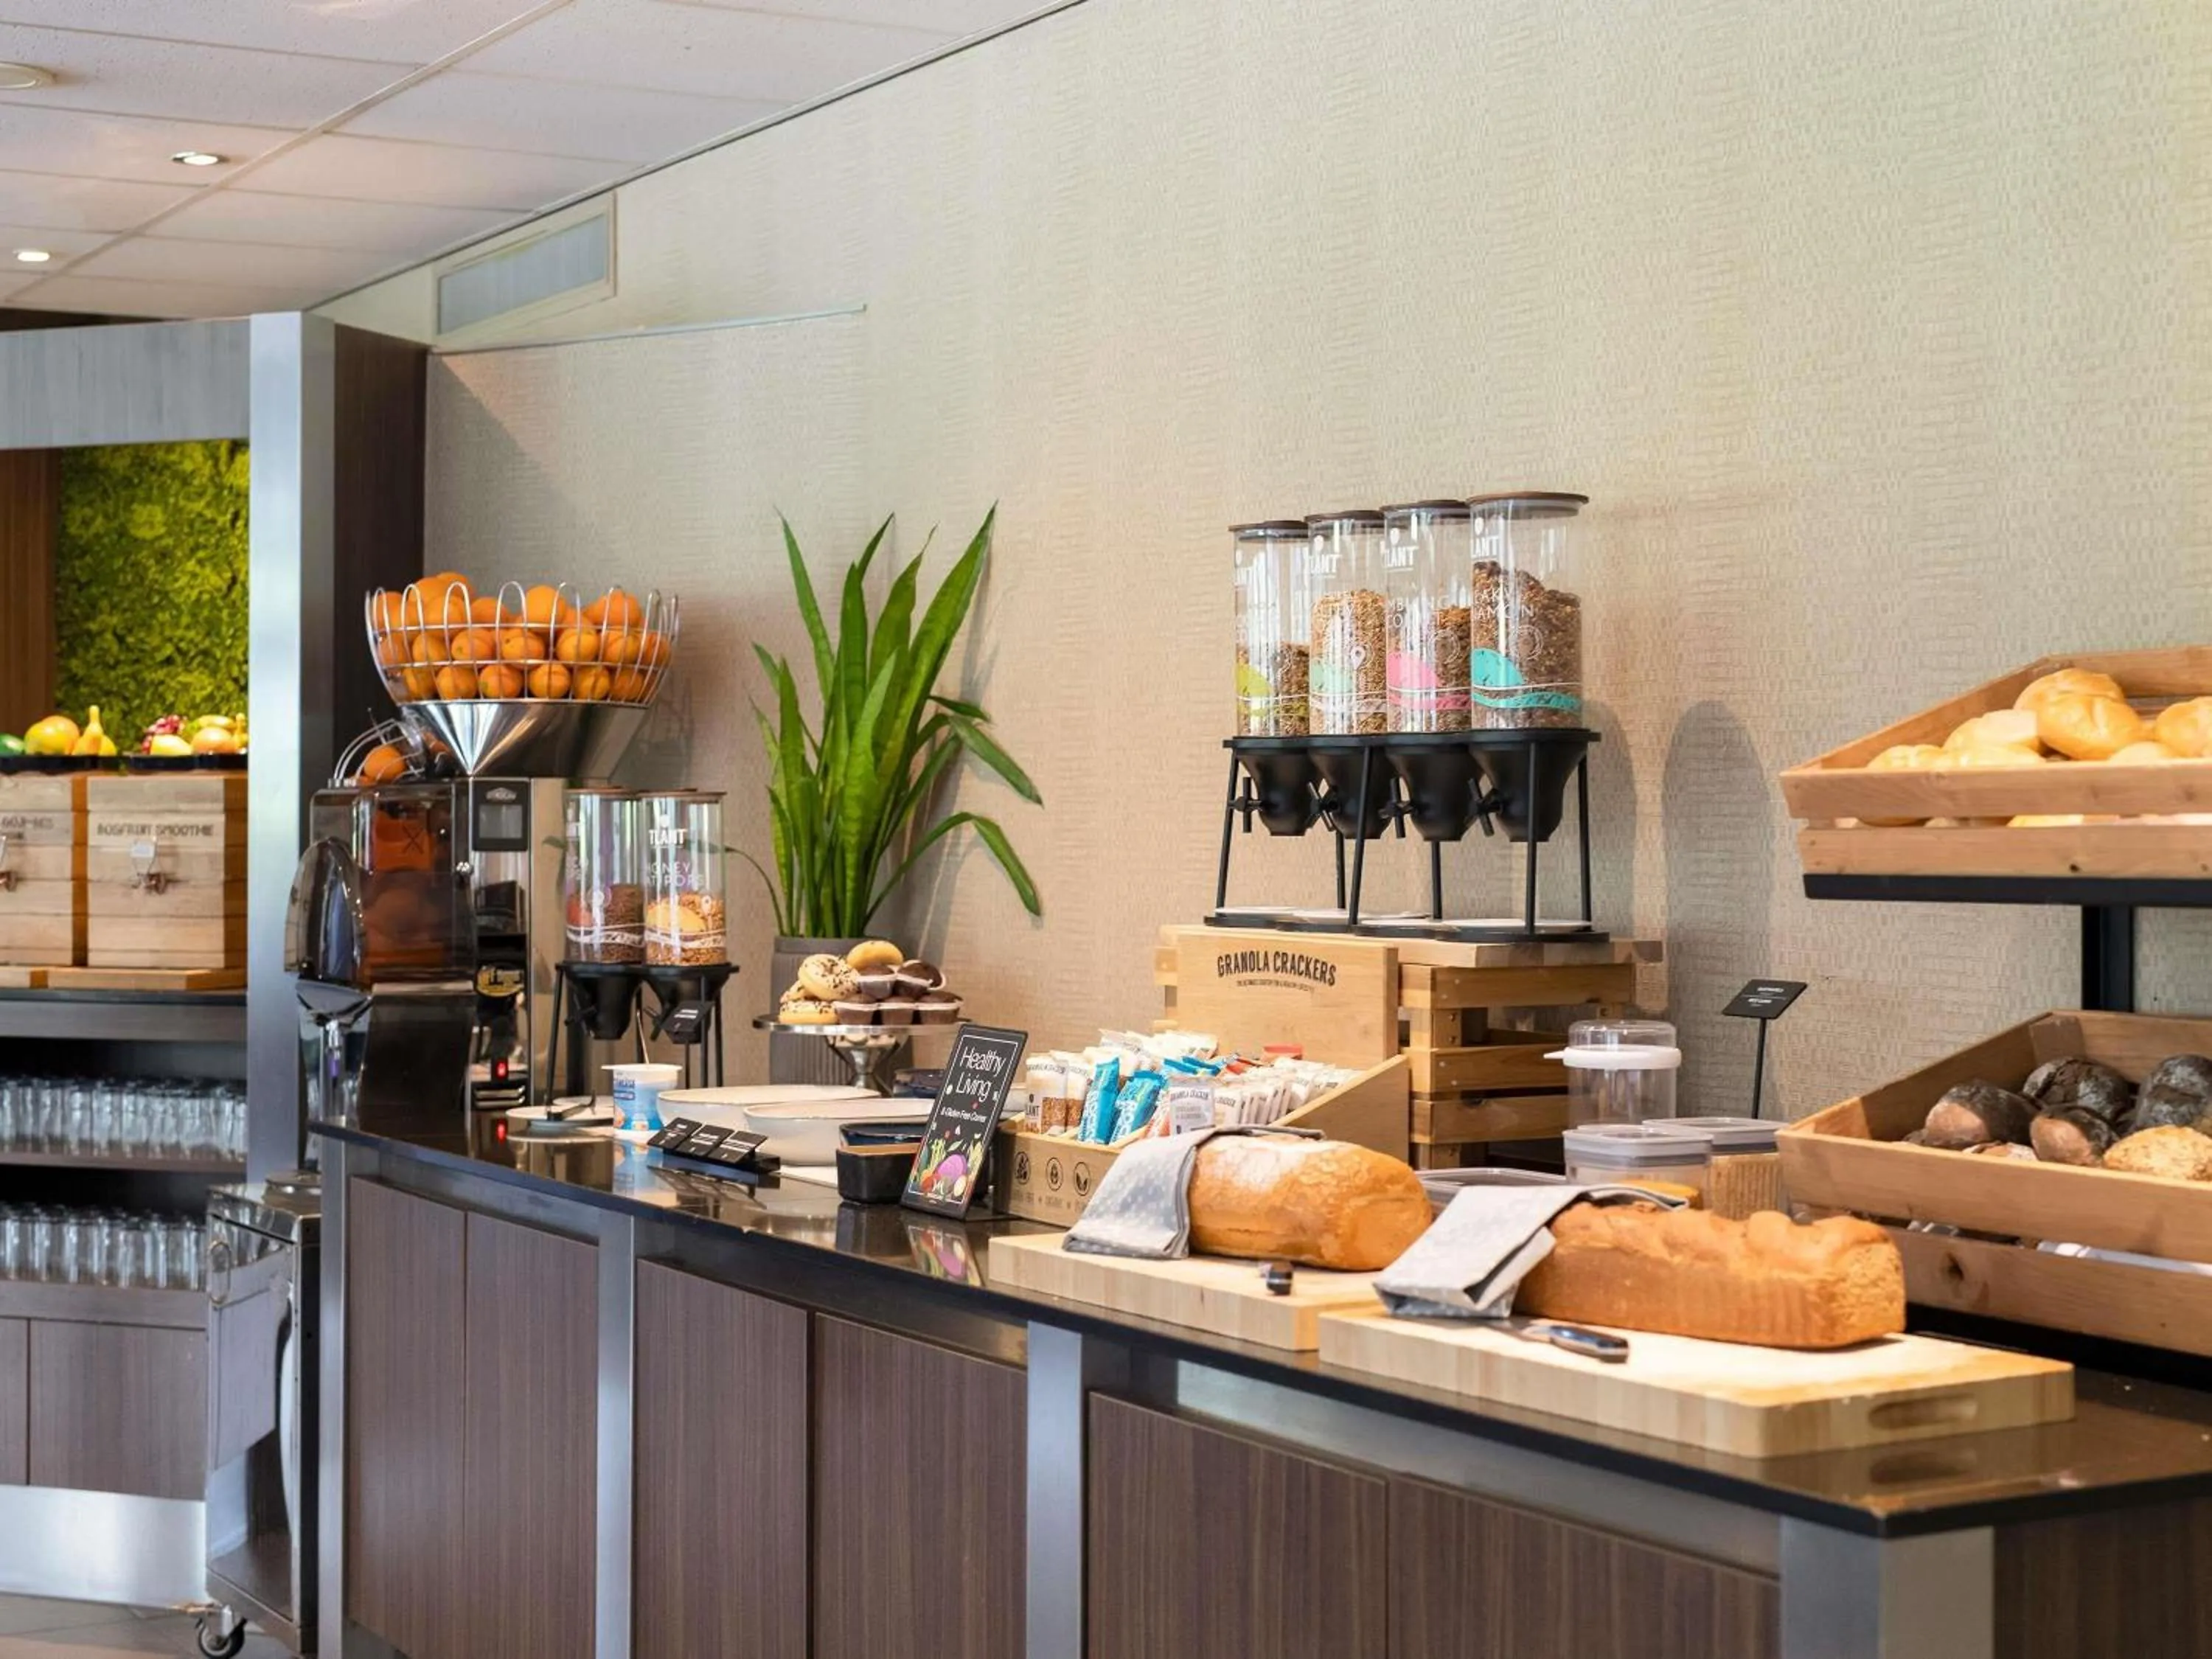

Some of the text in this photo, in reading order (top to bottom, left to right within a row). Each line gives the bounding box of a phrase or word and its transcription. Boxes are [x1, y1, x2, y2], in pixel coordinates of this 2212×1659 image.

[1217, 950, 1270, 978] GRANOLA
[1273, 950, 1337, 987] CRACKERS
[959, 1046, 1006, 1077] Healthy
[956, 1071, 992, 1102] Living
